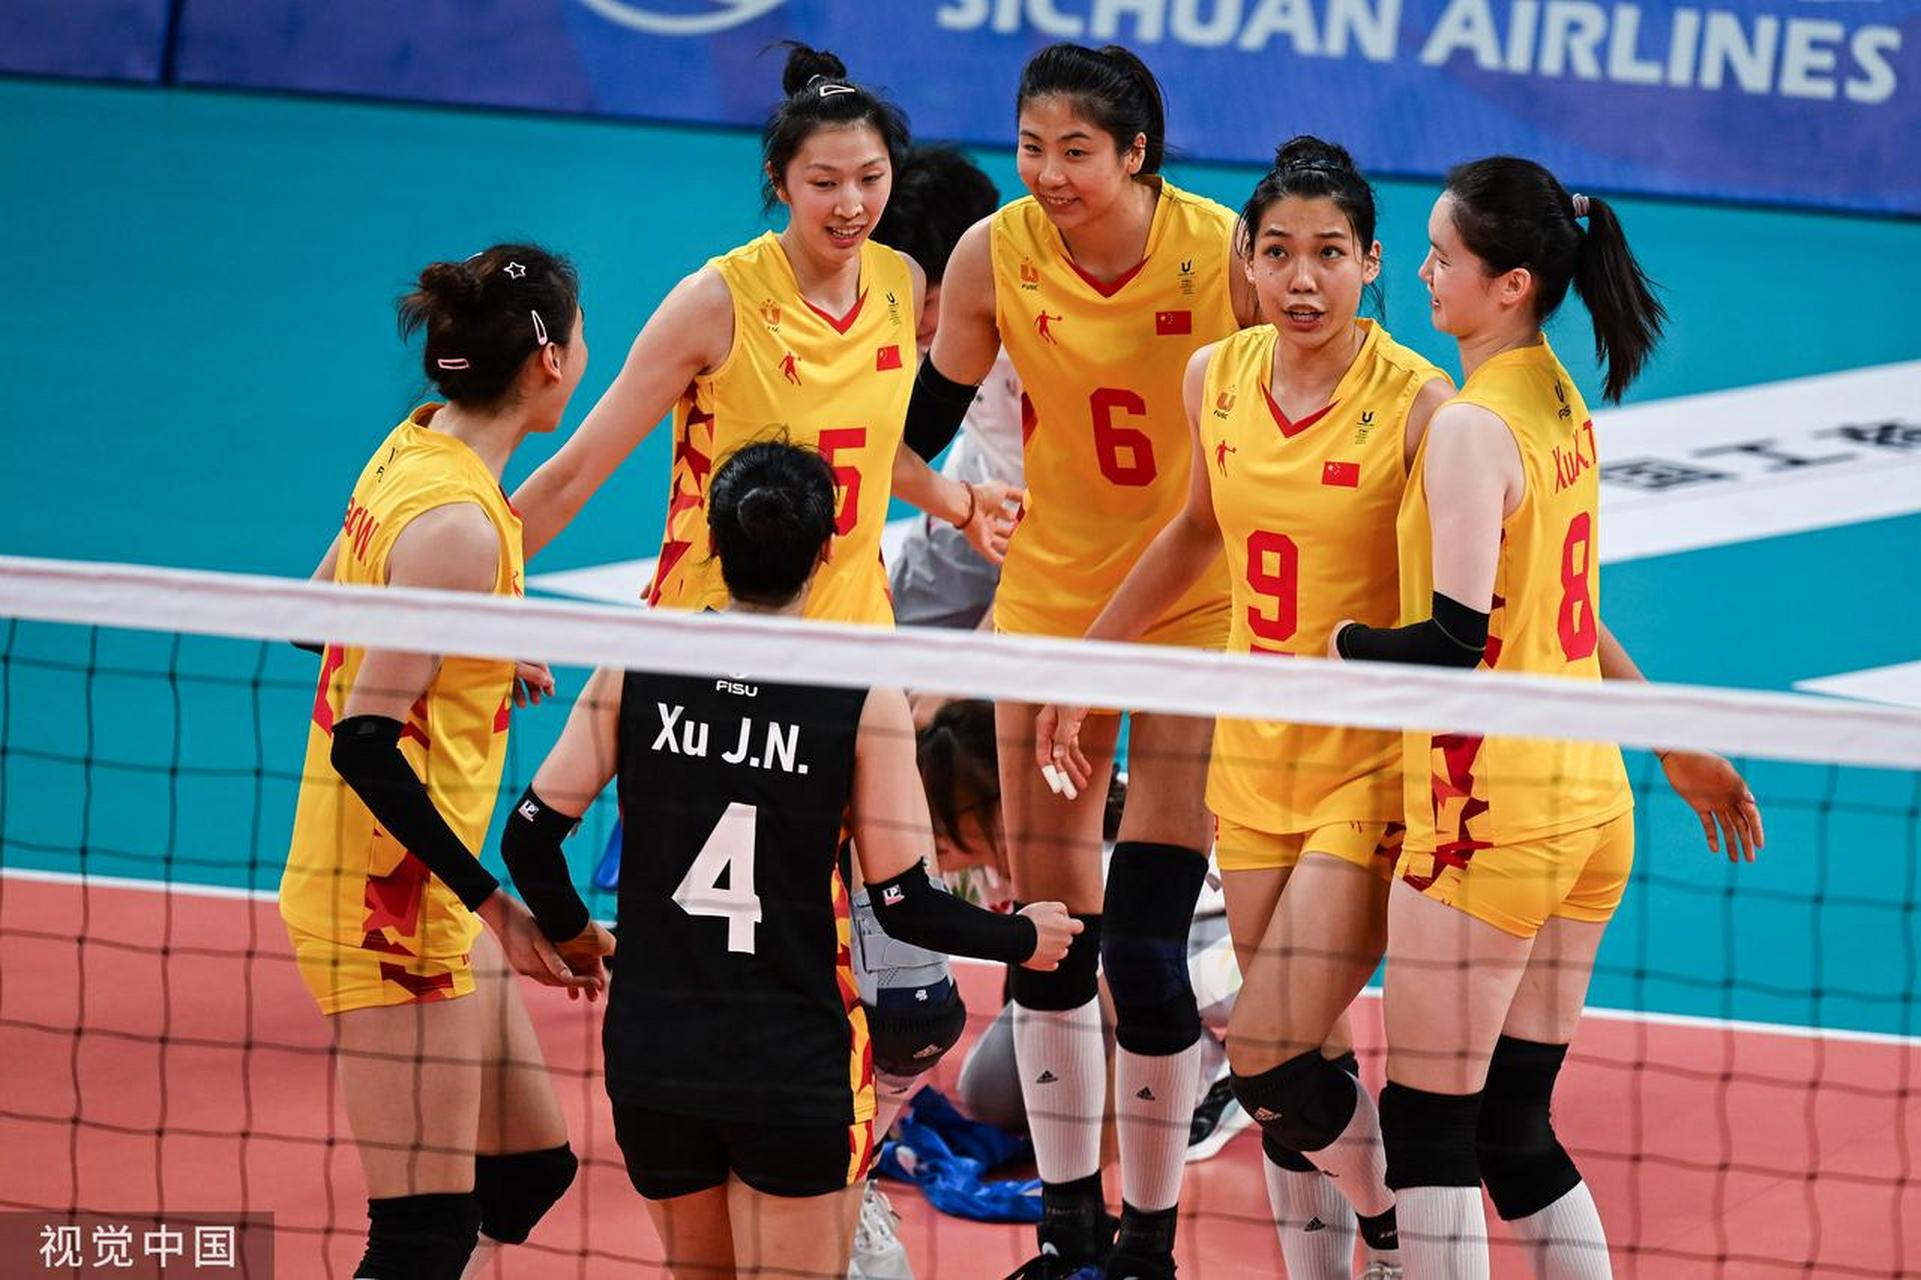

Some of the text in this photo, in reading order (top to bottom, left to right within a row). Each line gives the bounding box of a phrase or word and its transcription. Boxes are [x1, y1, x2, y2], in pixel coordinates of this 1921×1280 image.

[1420, 0, 1902, 104] AIRLINES
[817, 427, 867, 536] 5
[1089, 387, 1158, 487] 6
[1247, 529, 1299, 642] 9
[1557, 511, 1598, 662] 8
[651, 702, 809, 774] Xu J.N.
[716, 680, 758, 697] FISU
[671, 802, 762, 955] 4
